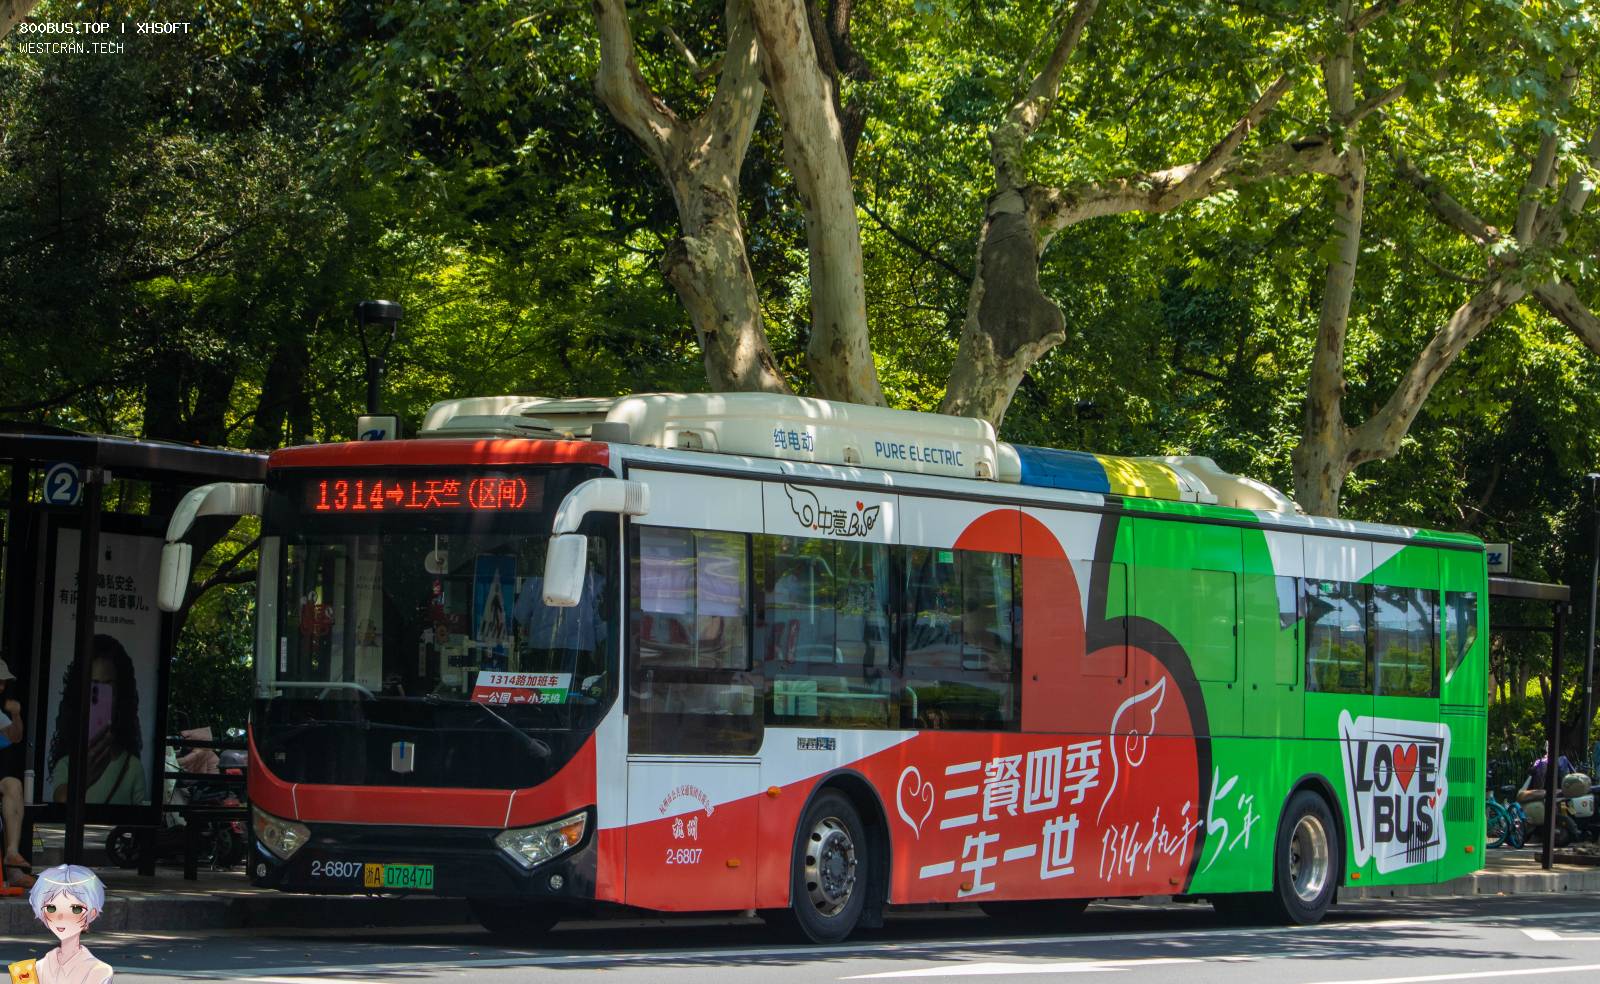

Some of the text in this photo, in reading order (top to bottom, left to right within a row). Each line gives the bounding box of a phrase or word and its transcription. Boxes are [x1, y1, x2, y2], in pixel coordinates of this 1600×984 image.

[773, 428, 814, 452] 纯电动
[875, 441, 964, 467] PURE ELECTRIC
[54, 472, 72, 501] 2
[315, 479, 384, 511] 1314
[490, 675, 559, 687] 1314路加班车
[477, 691, 512, 703] 一公园
[939, 739, 1102, 831] 三餐四季
[1373, 793, 1435, 845] BUS
[311, 859, 363, 878] 2-6807
[666, 848, 703, 865] 2-6807
[919, 813, 1080, 898] 一生一世
